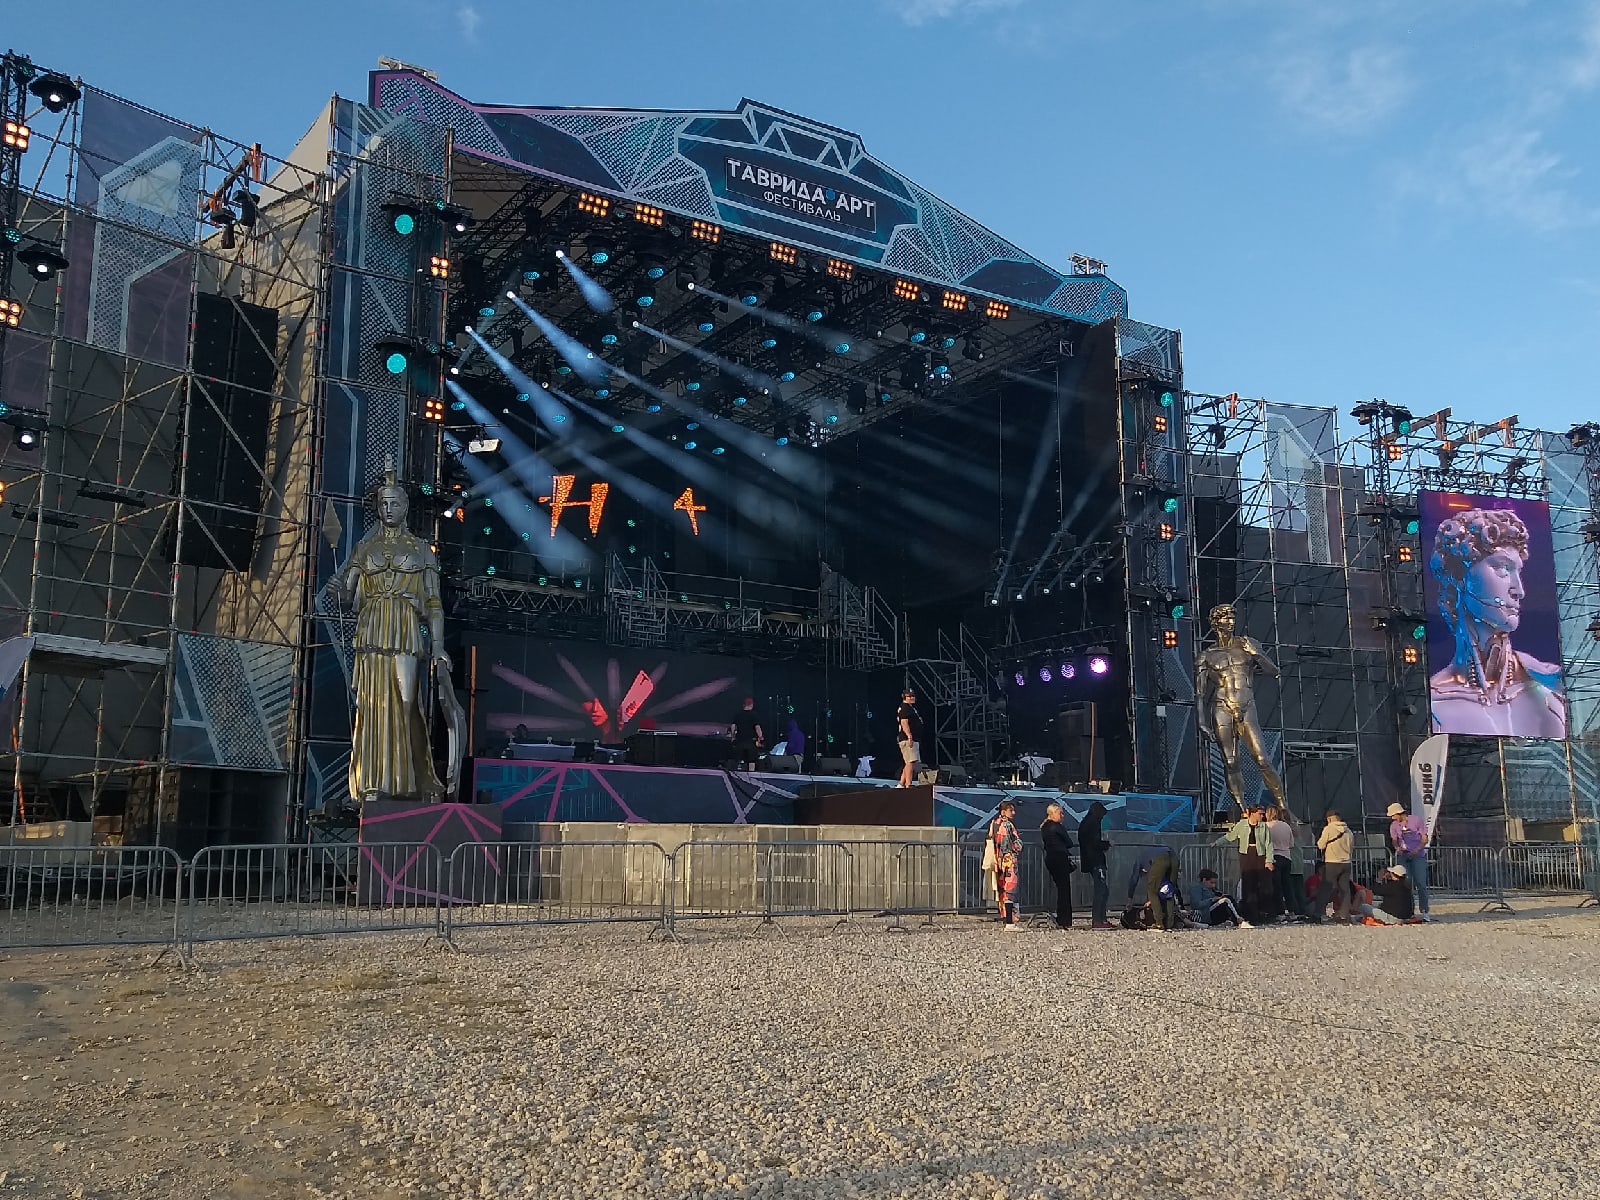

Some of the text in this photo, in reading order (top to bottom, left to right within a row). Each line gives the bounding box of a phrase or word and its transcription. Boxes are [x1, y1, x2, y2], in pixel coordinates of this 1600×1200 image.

[727, 159, 875, 218] ТАВРИДА АРТ
[763, 191, 841, 222] ФЕСТИВАЛЬ
